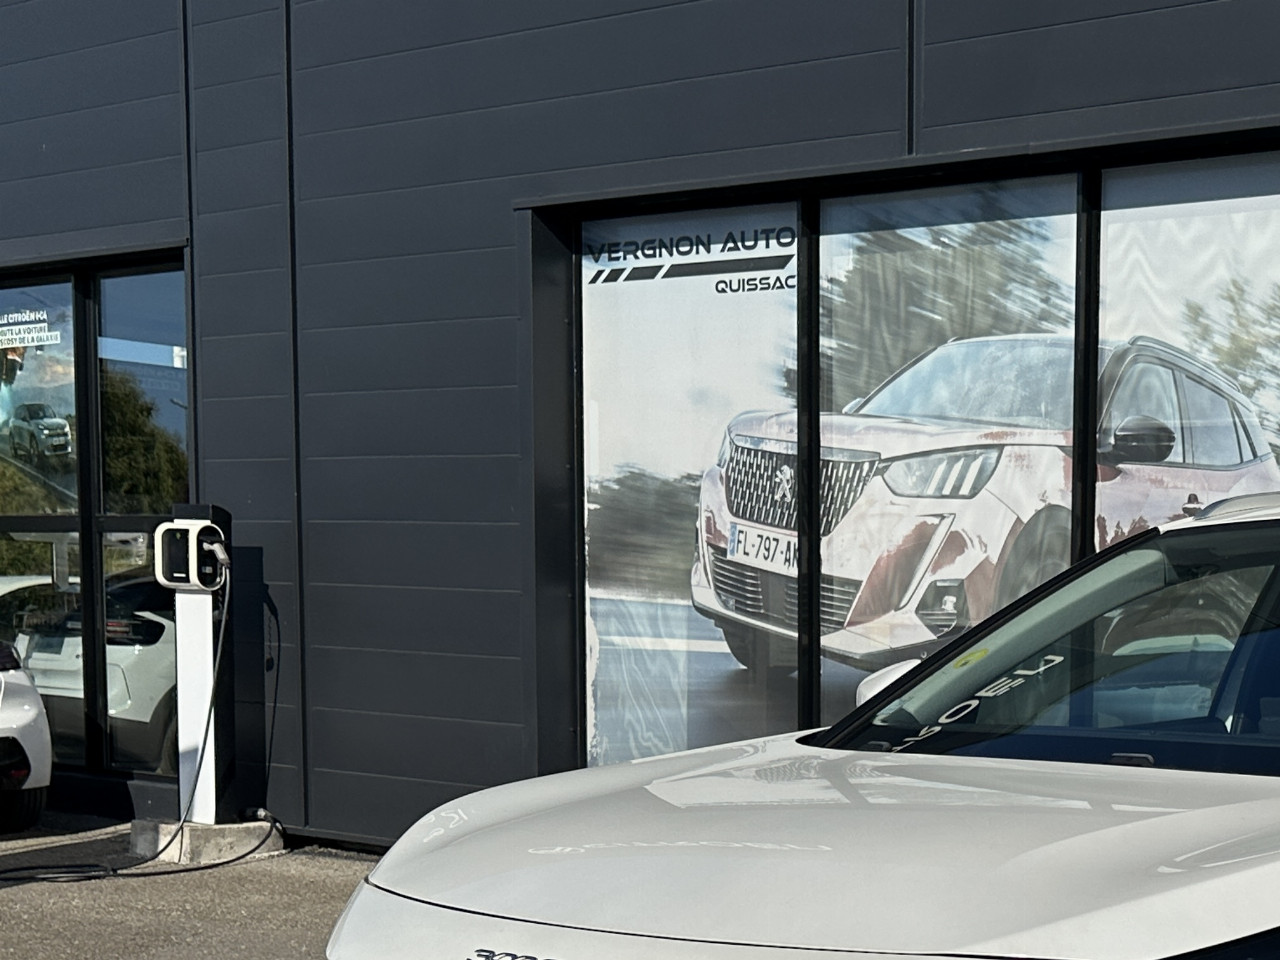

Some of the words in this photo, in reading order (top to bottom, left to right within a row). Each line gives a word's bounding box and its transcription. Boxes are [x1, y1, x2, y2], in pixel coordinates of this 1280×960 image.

[586, 233, 711, 263] VERGNON
[720, 226, 796, 253] AUTO
[715, 275, 797, 293] QUISSAC
